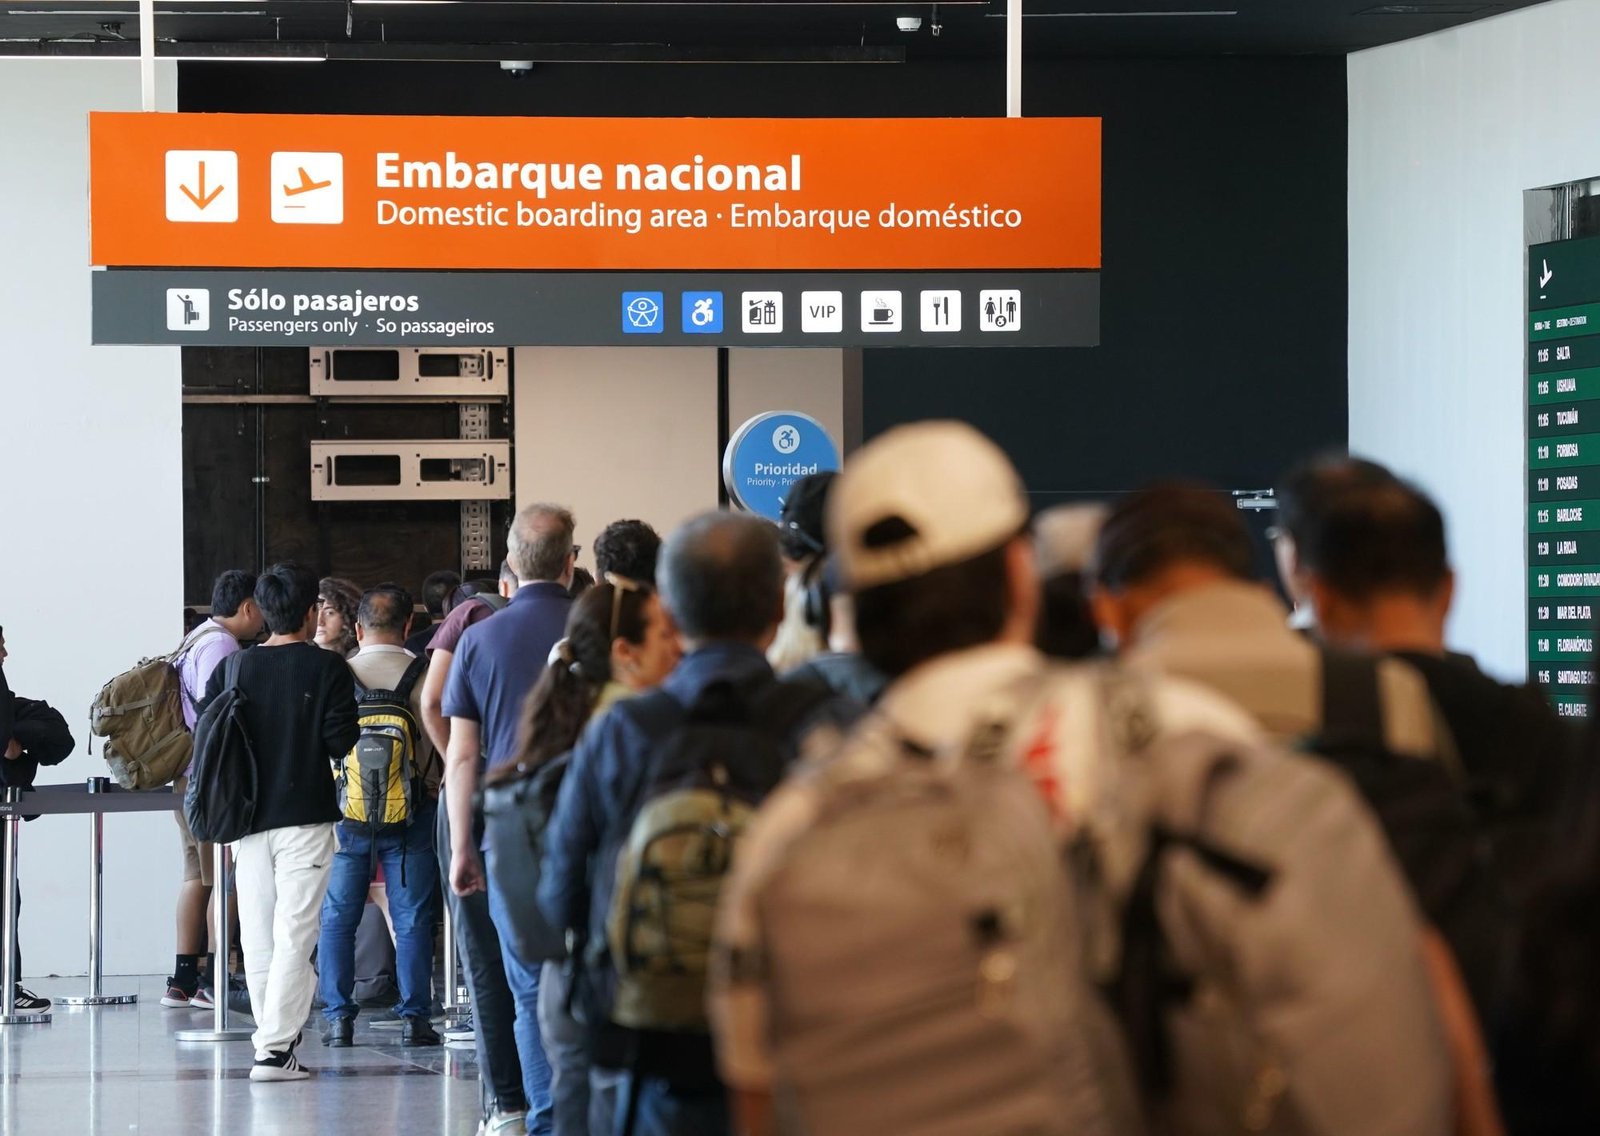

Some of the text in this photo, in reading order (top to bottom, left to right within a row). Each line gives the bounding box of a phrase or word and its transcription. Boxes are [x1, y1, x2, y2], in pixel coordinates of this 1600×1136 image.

[376, 152, 801, 199] Embarque nacional
[377, 200, 1022, 234] Domestic boarding area Embarque doméstico
[228, 288, 419, 316] Sólo pasajeros
[809, 305, 836, 318] VIP
[228, 317, 495, 336] Passengers only So passageiros
[1557, 345, 1571, 360] SALTA
[1557, 377, 1576, 393] USHUAIA
[1557, 407, 1578, 425] TUCUMÁN
[1557, 443, 1579, 458] FORMOSA
[755, 463, 817, 475] Prioridad
[747, 477, 777, 488] Priority
[1557, 475, 1578, 490] POSADAS
[1557, 507, 1582, 522] BARILOCHE
[1557, 541, 1563, 555] LA
[1563, 540, 1578, 555] RIOJA
[1557, 573, 1583, 588] COMODORO
[1557, 605, 1568, 620] MAR
[1568, 605, 1577, 620] DEL
[1577, 605, 1592, 620] PLATA
[1557, 635, 1593, 652] FLORIANÓPOLIS
[1557, 670, 1580, 684] SANTIAGO
[1580, 670, 1587, 684] DE
[1558, 702, 1588, 717] EL CALAFATE
